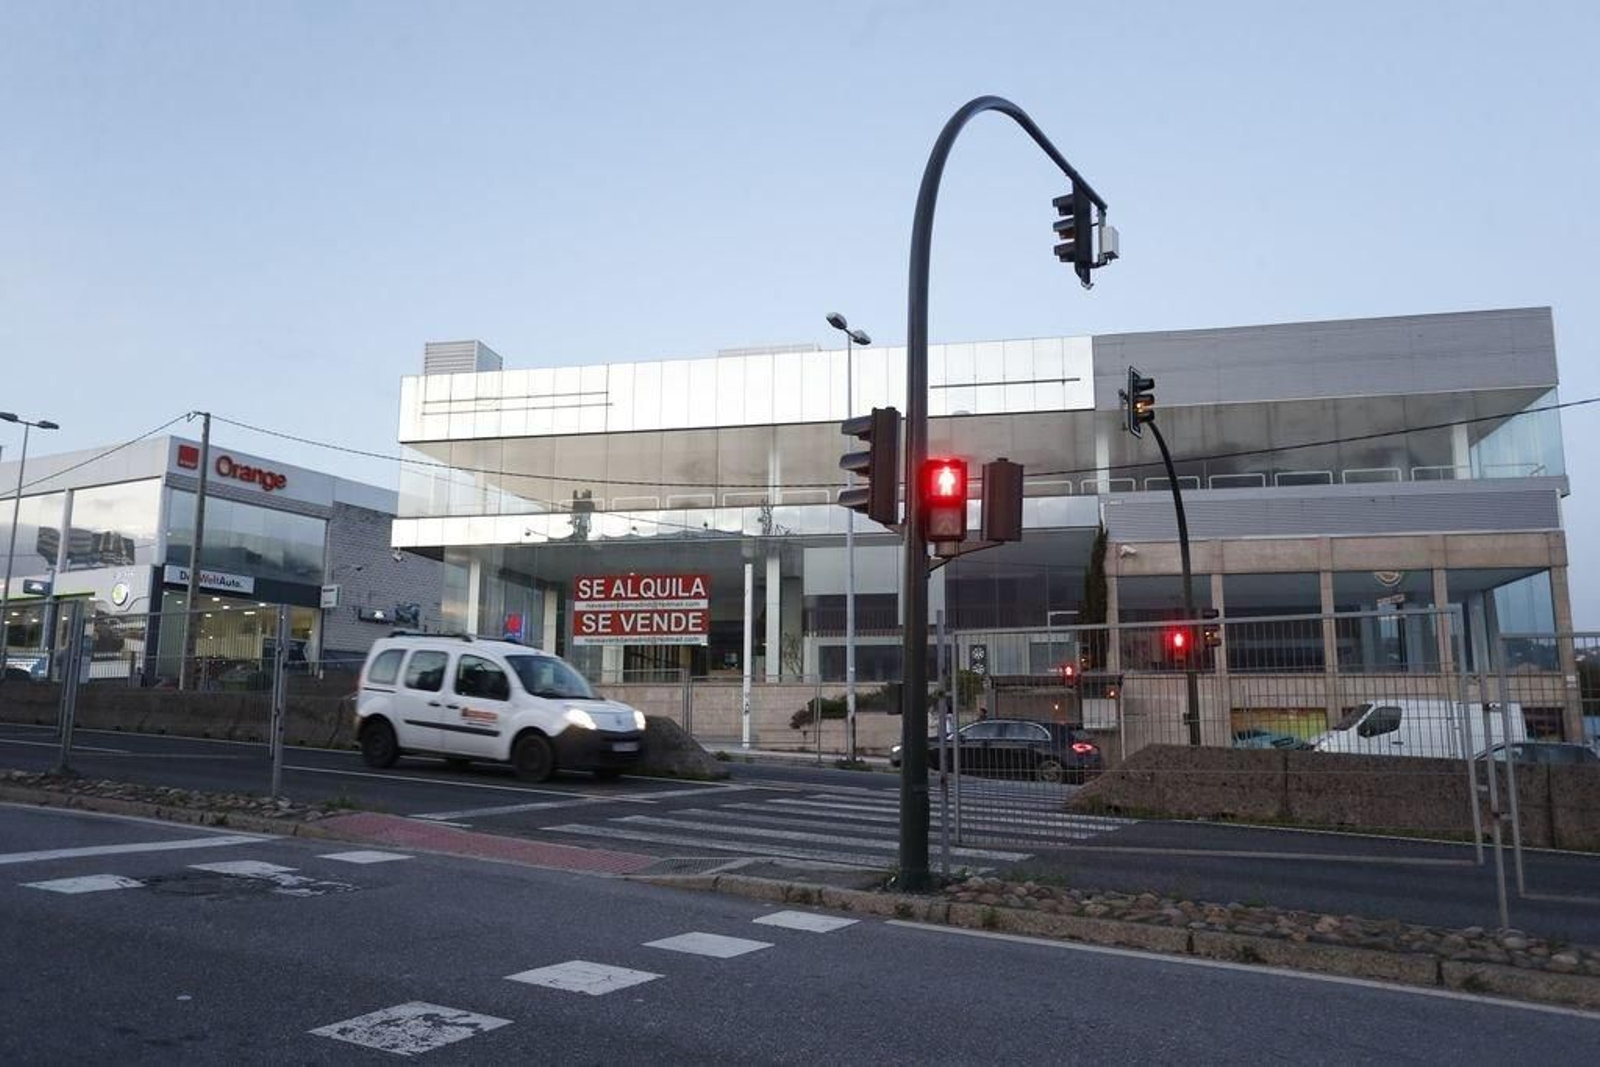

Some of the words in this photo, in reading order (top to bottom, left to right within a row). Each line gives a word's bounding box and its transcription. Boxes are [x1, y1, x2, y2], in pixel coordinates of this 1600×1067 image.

[216, 455, 287, 490] Orange
[578, 578, 606, 599] SE
[611, 577, 706, 598] ALQUILA
[582, 613, 612, 633] SE
[620, 612, 703, 632] VENDE
